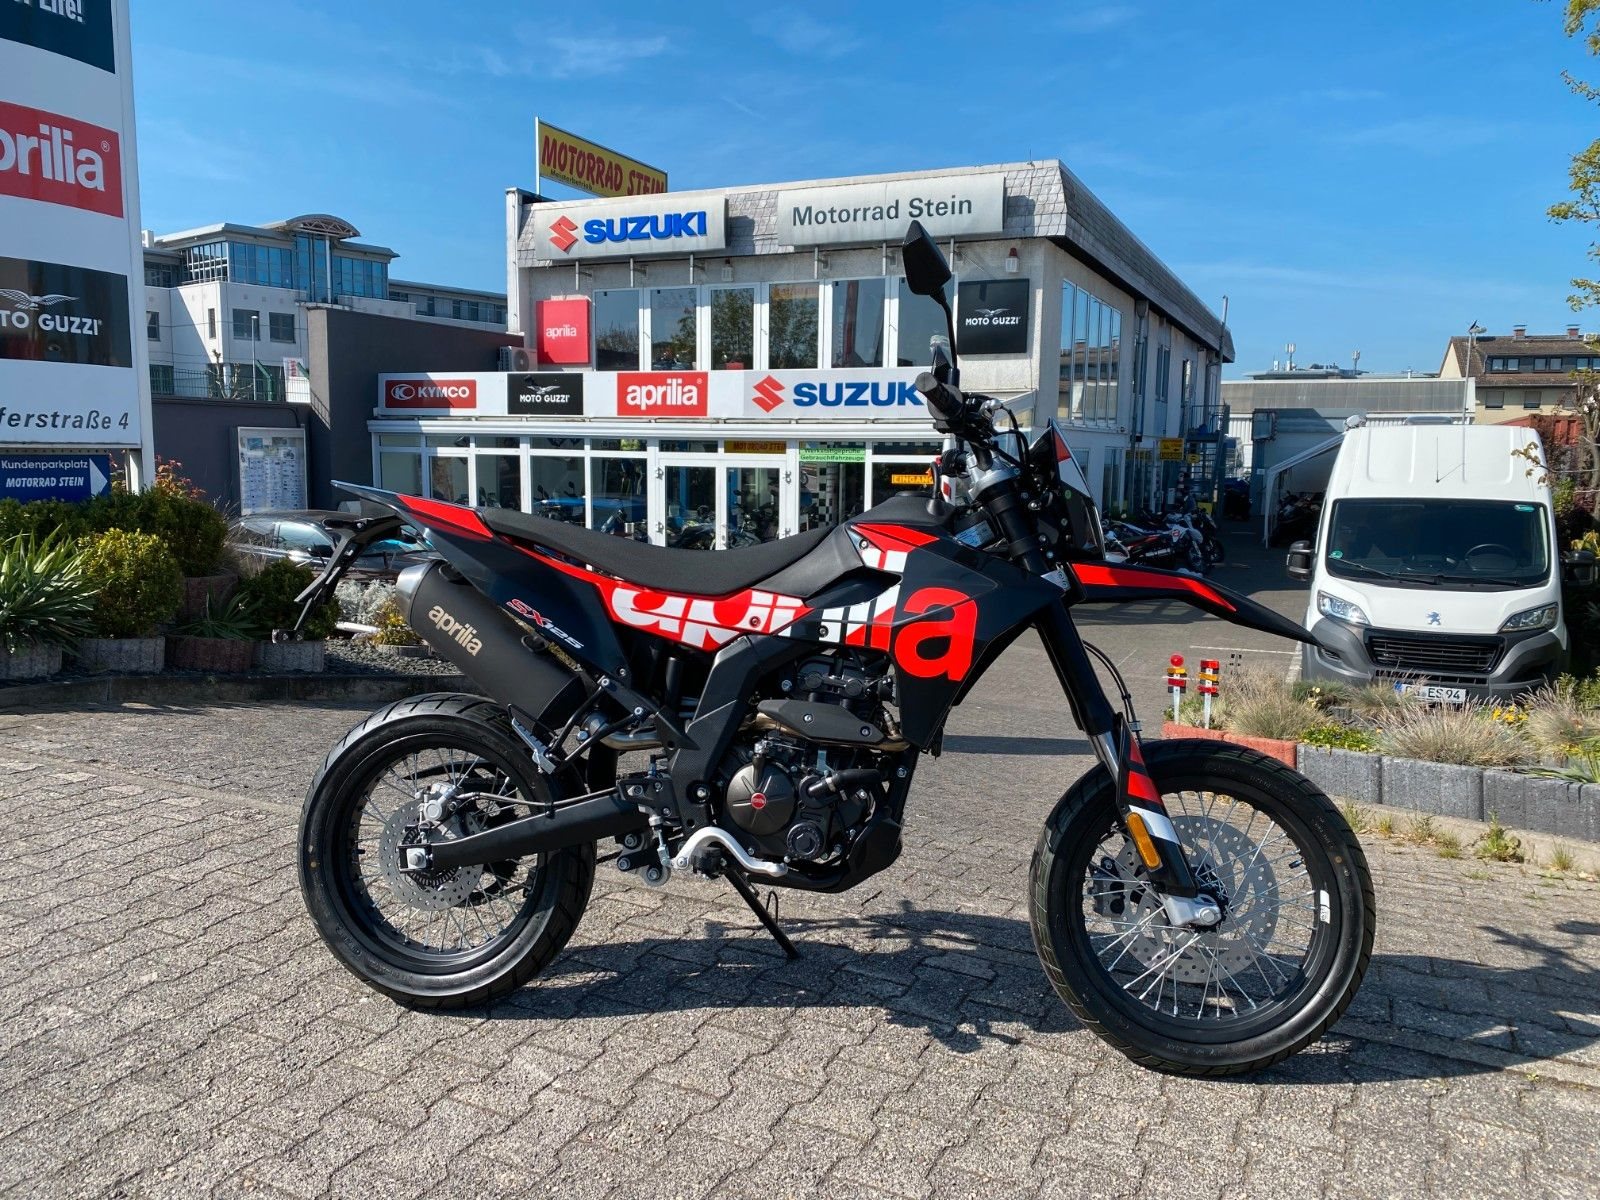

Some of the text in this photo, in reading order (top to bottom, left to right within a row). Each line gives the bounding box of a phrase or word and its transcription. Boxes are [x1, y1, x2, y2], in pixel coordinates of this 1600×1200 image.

[541, 135, 624, 192] MOTORRAD
[792, 194, 972, 226] Motorrad Stein
[583, 211, 707, 244] SUZUKI
[38, 313, 99, 336] GUZZI
[545, 323, 577, 340] aprilia
[965, 316, 1019, 327] MOTO GUZZI
[417, 385, 470, 398] KYMCO
[519, 394, 568, 403] MOTO GUZZI
[626, 378, 698, 411] aprilia
[792, 381, 925, 407] SUZUK
[119, 412, 129, 430] 4
[1, 460, 89, 471] Kundenparkplatz
[6, 476, 84, 488] MOTORRAD STEIN
[428, 605, 483, 657] aprilia
